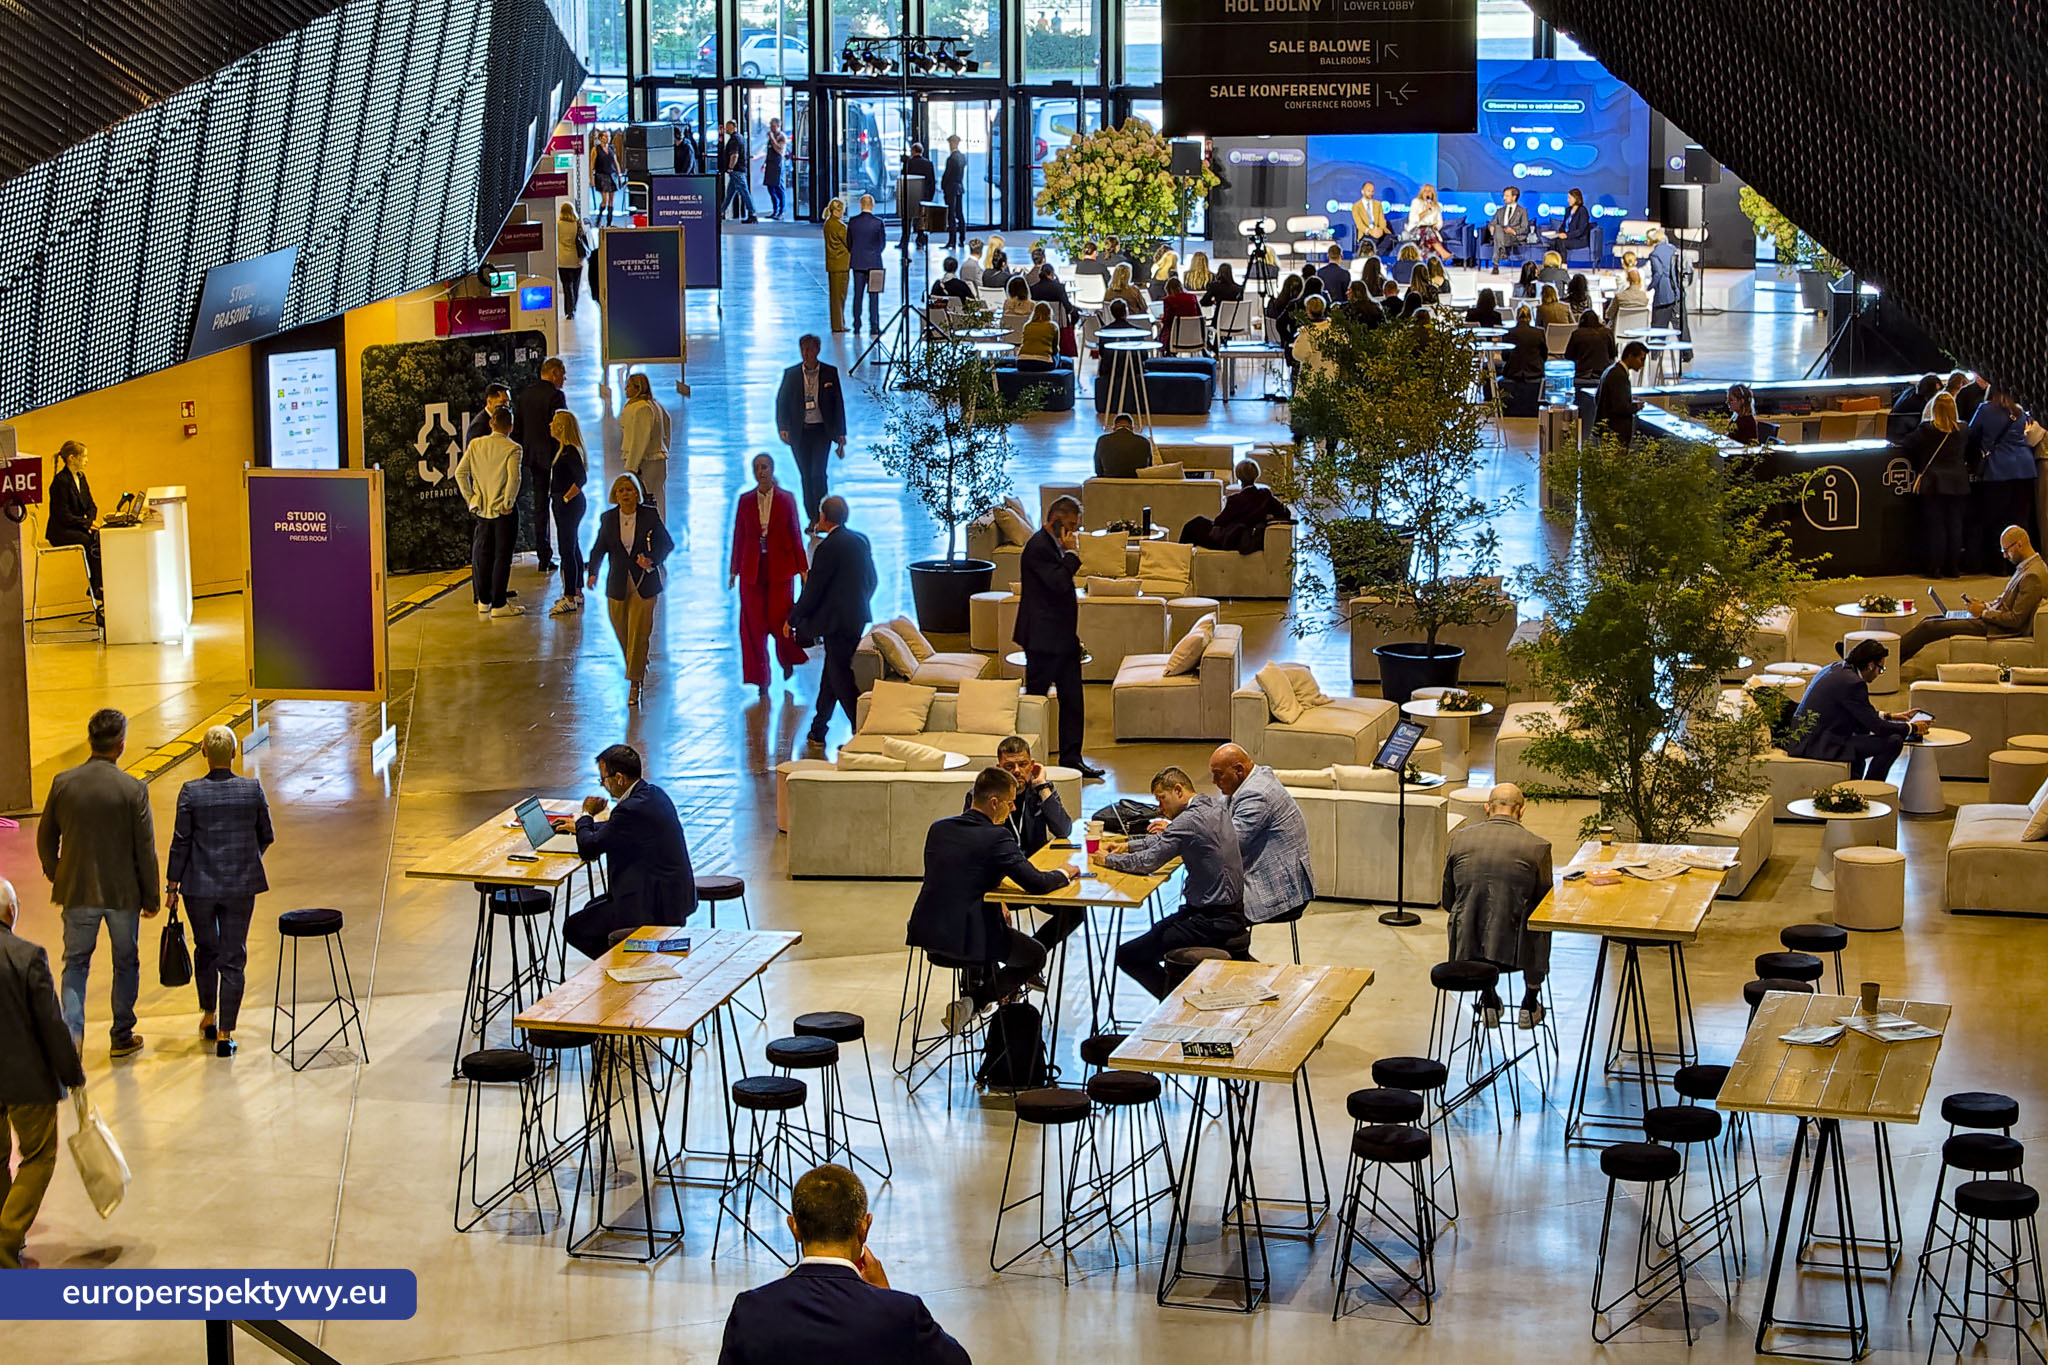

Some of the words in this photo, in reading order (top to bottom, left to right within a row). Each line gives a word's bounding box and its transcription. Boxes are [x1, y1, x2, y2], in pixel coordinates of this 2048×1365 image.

[1225, 0, 1260, 12] HOL
[1264, 0, 1322, 12] DOLNY
[1343, 1, 1380, 11] LOWER
[1383, 0, 1415, 10] LOBBY
[1269, 41, 1305, 53] SALE
[1309, 40, 1371, 53] BALOWE
[1320, 56, 1371, 65] BALLROOMS
[1210, 85, 1246, 98] SALE
[1250, 83, 1371, 98] KONFERENCYJNE
[1284, 101, 1339, 110] CONFERENCE
[1341, 100, 1371, 109] ROOMS
[212, 304, 253, 331] PRASOWE
[1, 473, 37, 493] ABC
[420, 488, 458, 500] OPERATOR
[286, 511, 327, 521] STUDIO
[274, 522, 327, 532] PRASOWE
